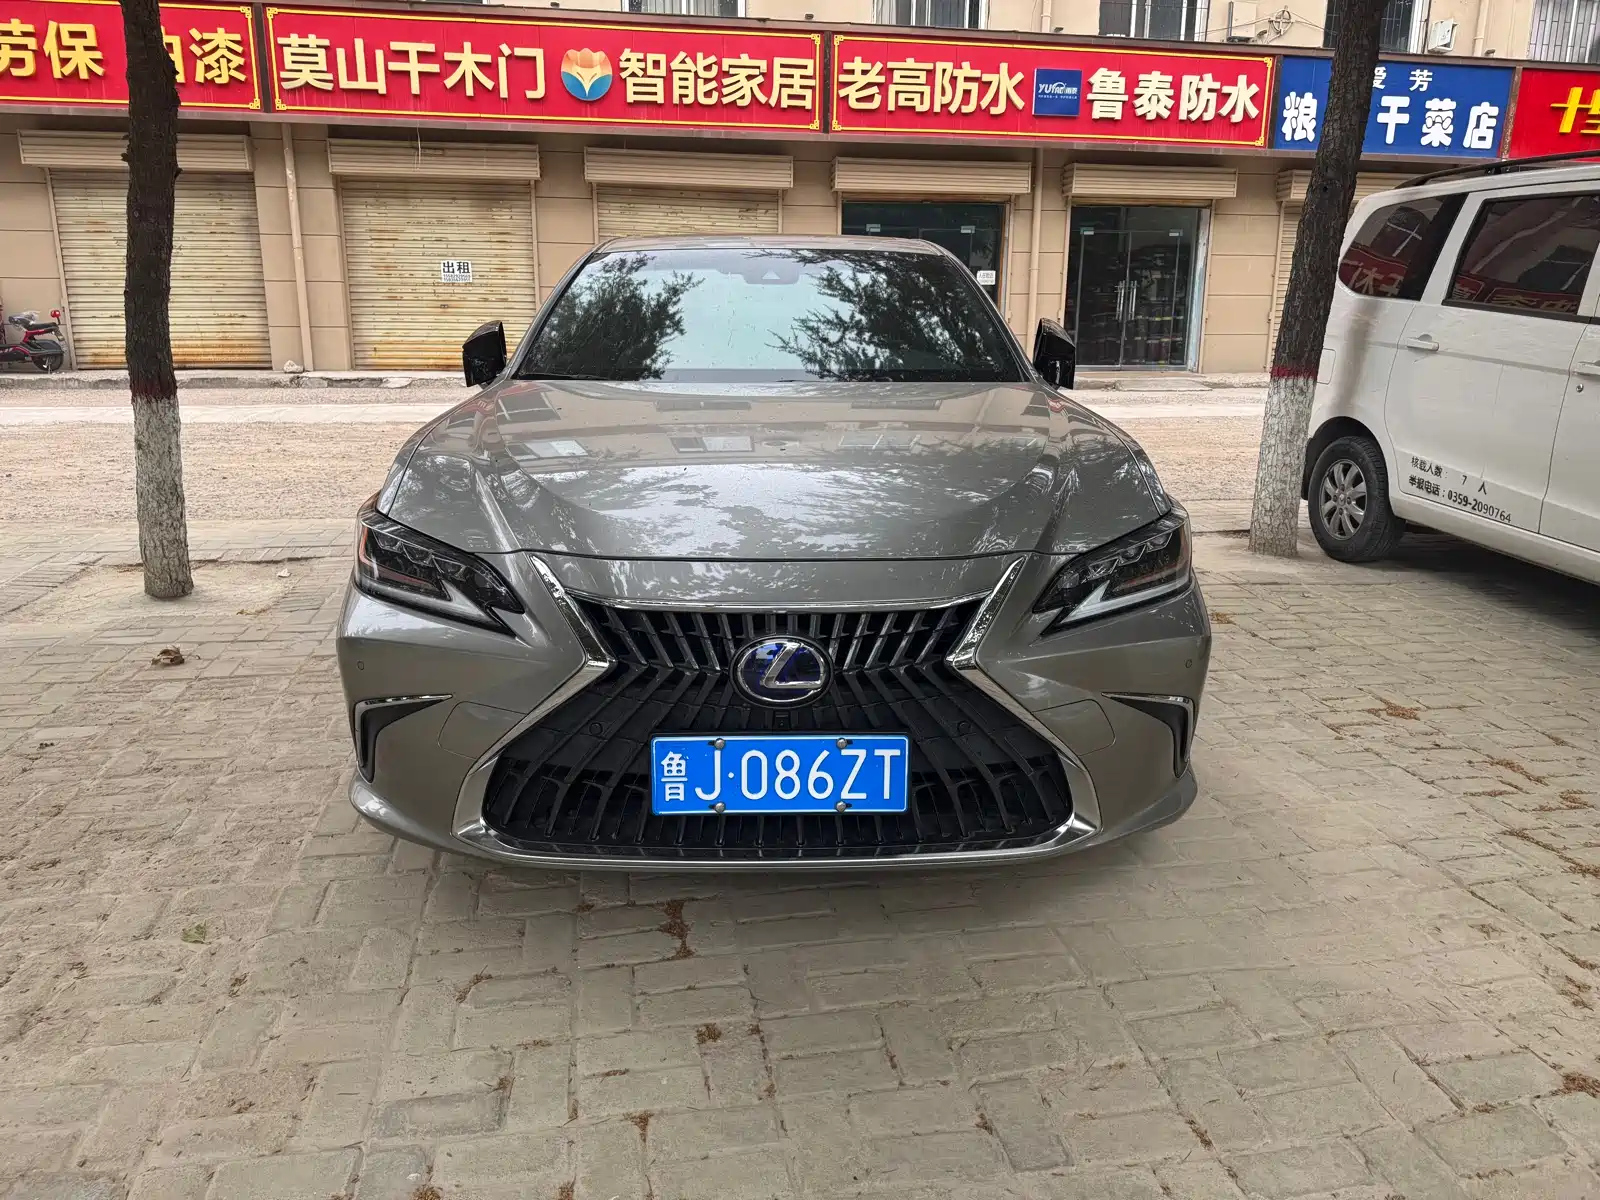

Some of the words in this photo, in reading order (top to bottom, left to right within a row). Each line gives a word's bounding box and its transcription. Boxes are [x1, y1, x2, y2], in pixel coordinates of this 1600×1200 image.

[0, 18, 106, 80] 劳保
[160, 26, 248, 85] 漆
[277, 33, 547, 100] 莫山干木门
[618, 48, 817, 111] 智能家居
[838, 56, 1026, 115] 老高防水
[1086, 67, 1261, 123] 鲁泰防水
[442, 261, 471, 274] 出租
[1461, 474, 1468, 486] 7
[1478, 481, 1488, 496] 人
